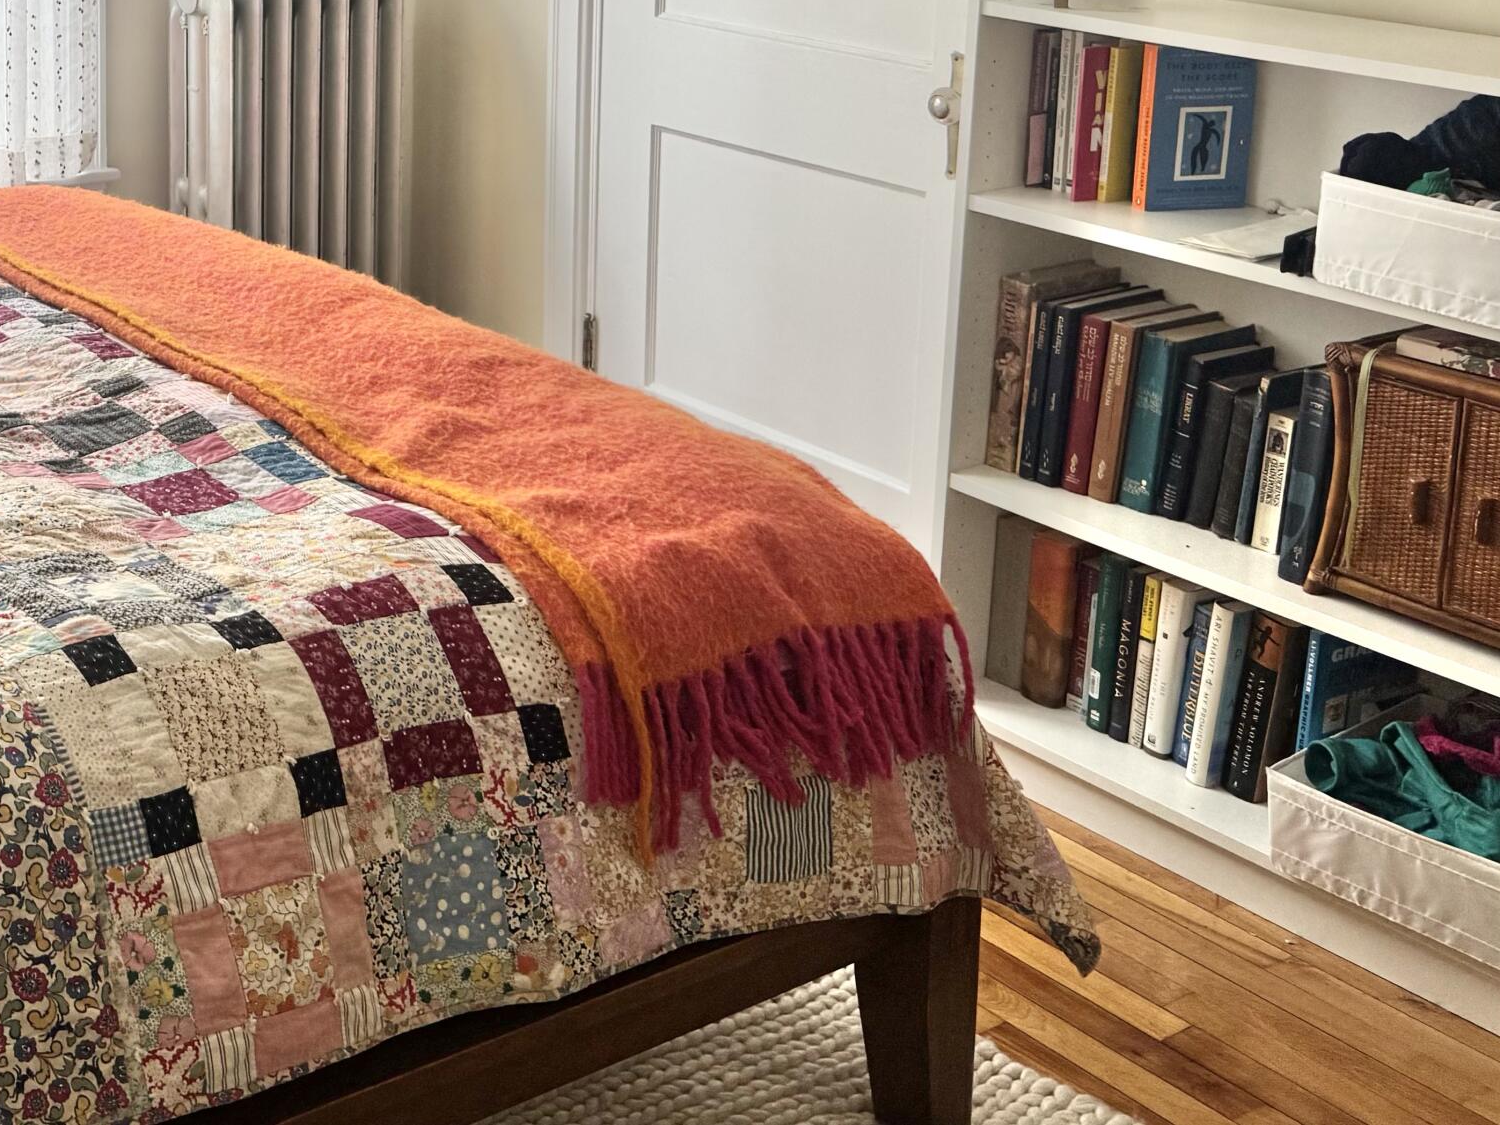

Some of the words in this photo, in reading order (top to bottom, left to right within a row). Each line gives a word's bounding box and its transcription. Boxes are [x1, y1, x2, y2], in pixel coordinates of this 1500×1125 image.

[1213, 613, 1222, 634] ARI
[1114, 619, 1131, 699] MAGONIA
[1205, 634, 1219, 677] SHAVIT
[1246, 669, 1254, 691] FAR
[1240, 690, 1250, 720] FROM
[1251, 675, 1265, 724] ANDREW
[1235, 720, 1244, 741] THE
[1230, 742, 1240, 769] TREE
[1241, 723, 1256, 777] SOLOMON
